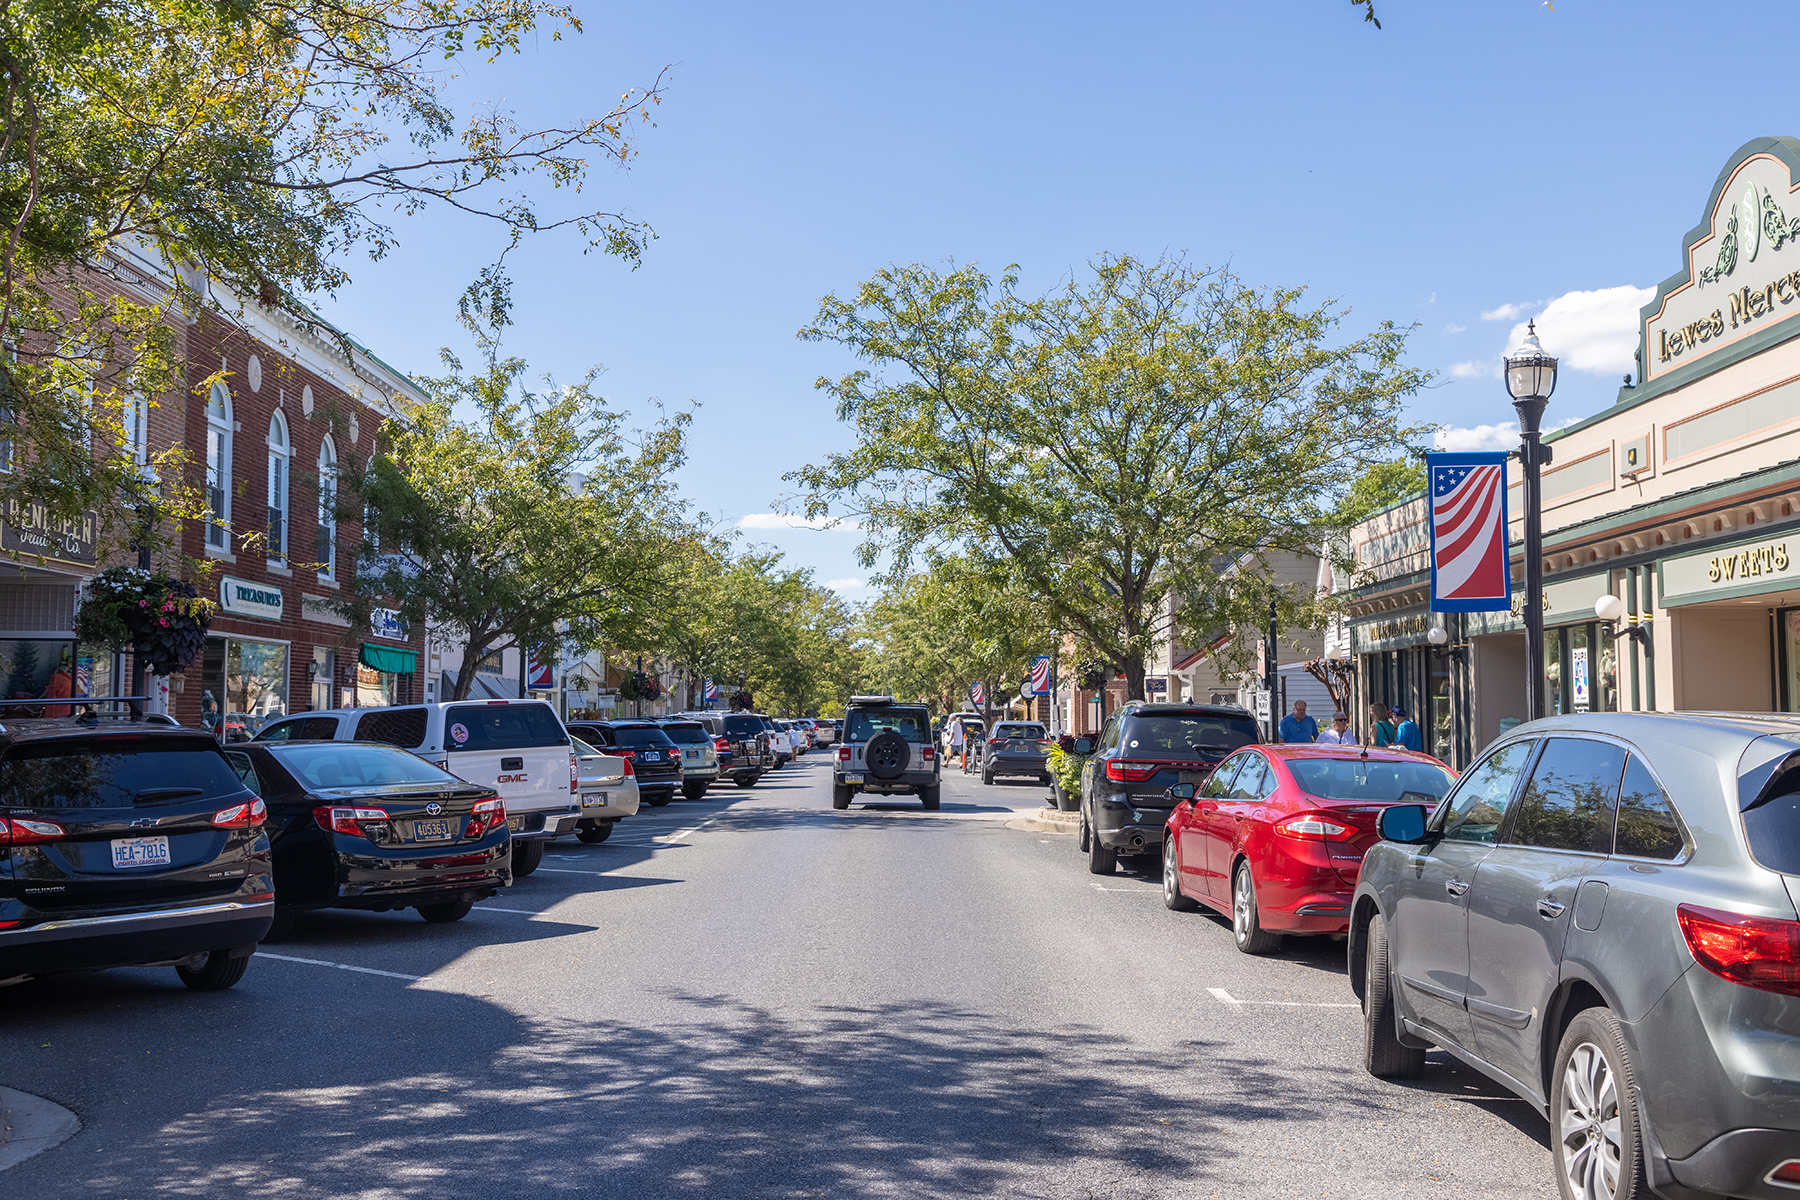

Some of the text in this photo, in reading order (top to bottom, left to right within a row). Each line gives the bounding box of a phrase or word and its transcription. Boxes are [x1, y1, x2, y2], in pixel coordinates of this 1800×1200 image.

[1657, 309, 1724, 363] Lewes
[1707, 543, 1790, 583] SWEETS
[1258, 694, 1268, 702] ONE
[498, 774, 528, 784] GMC
[418, 823, 447, 836] 405363
[115, 843, 167, 861] HEA-7816
[25, 886, 66, 895] EQUINOX
